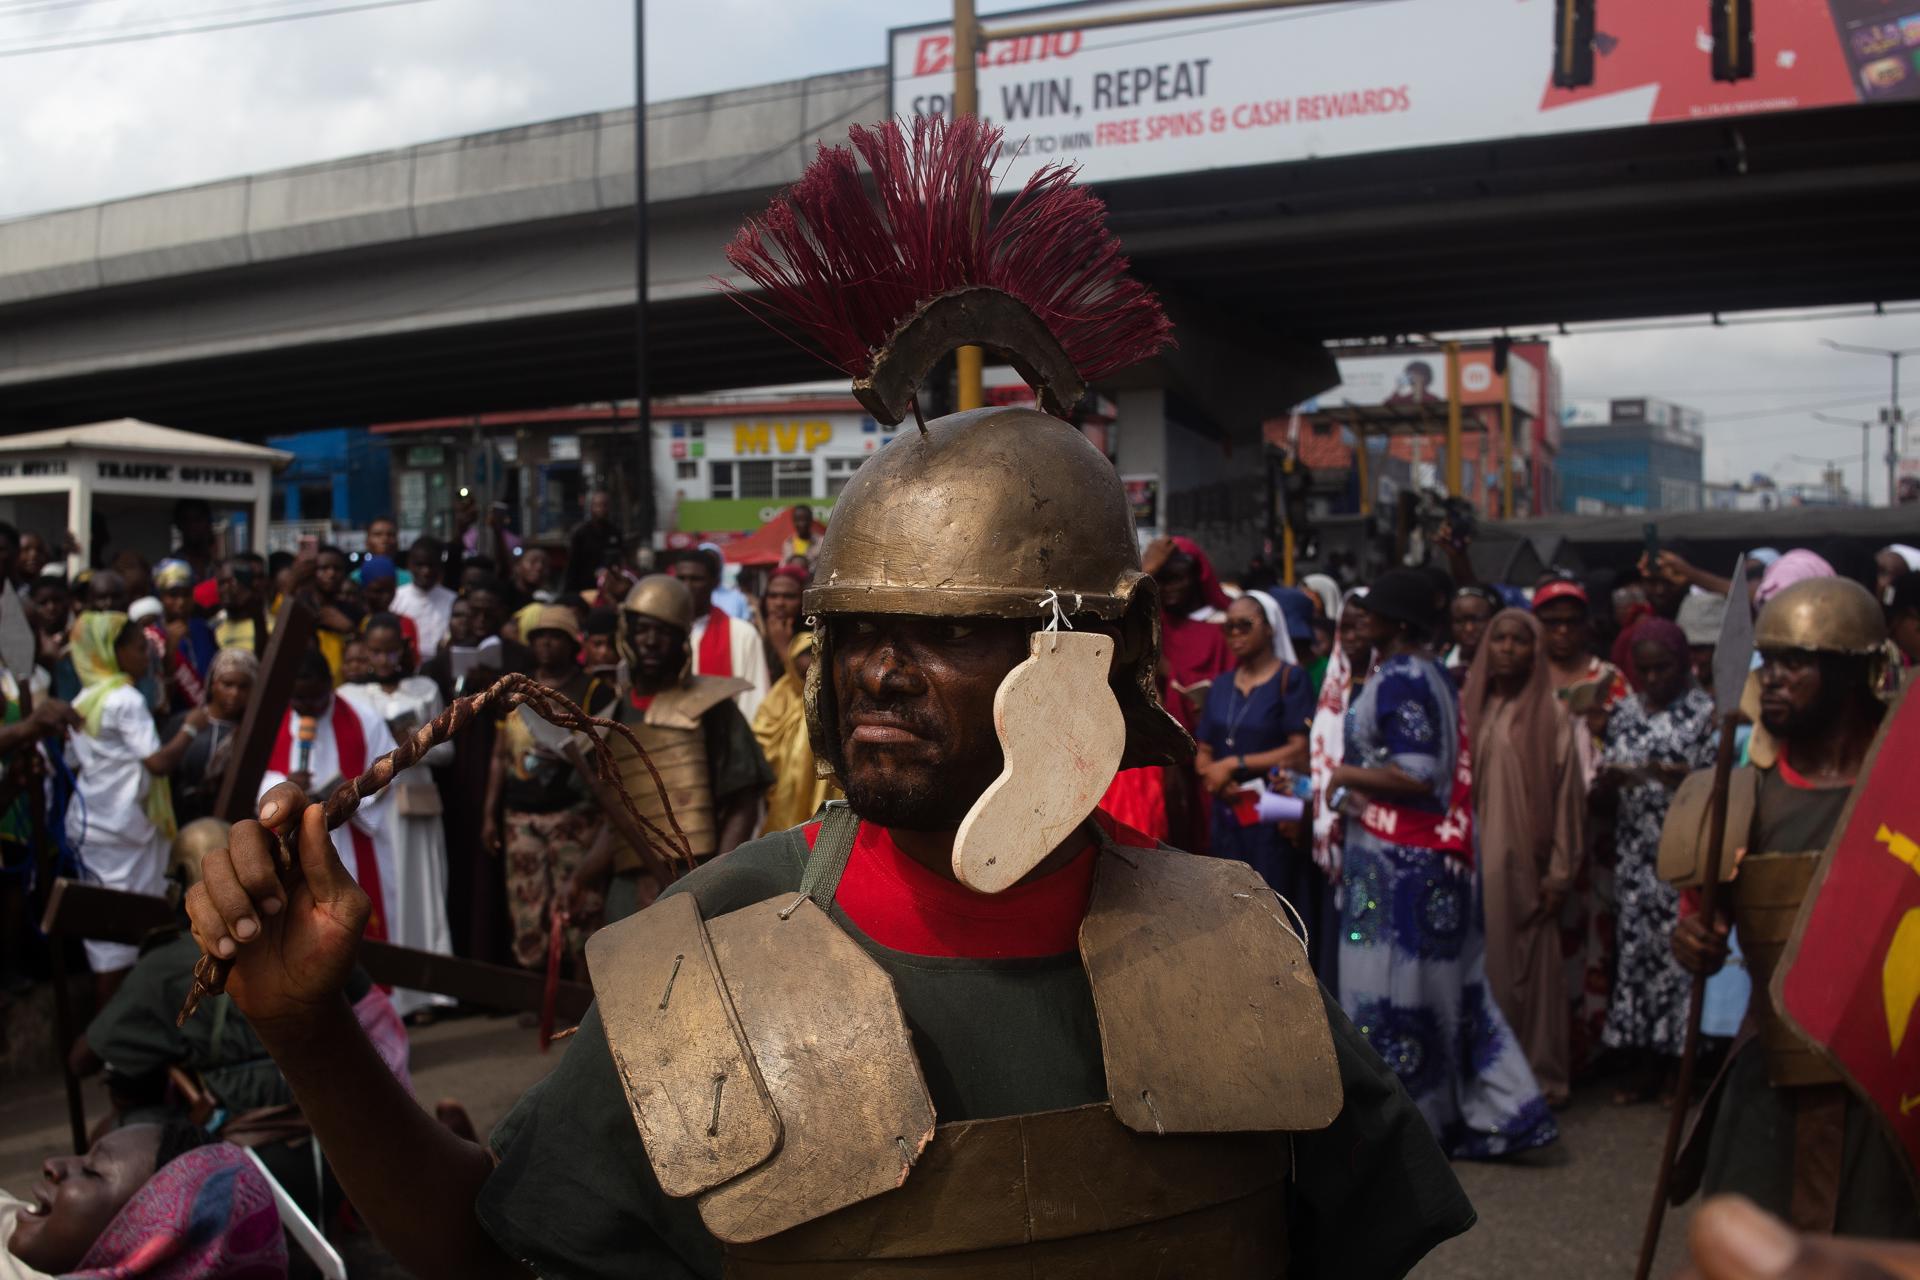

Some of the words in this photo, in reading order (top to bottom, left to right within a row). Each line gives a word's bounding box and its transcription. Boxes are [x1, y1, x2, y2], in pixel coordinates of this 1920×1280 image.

[912, 30, 1083, 77] Btano
[1001, 77, 1082, 122] WIN,
[1092, 58, 1211, 111] REPEAT
[1034, 136, 1057, 155] TO
[1060, 131, 1092, 151] WIN
[1095, 115, 1139, 147] FREE
[1145, 107, 1204, 142] SPINS
[1209, 107, 1227, 133] &
[1232, 98, 1290, 131] CASH
[1296, 85, 1411, 122] REWARDS
[734, 419, 832, 455] MVP
[97, 461, 175, 481] TRAFFIC
[180, 467, 254, 486] OFFICER
